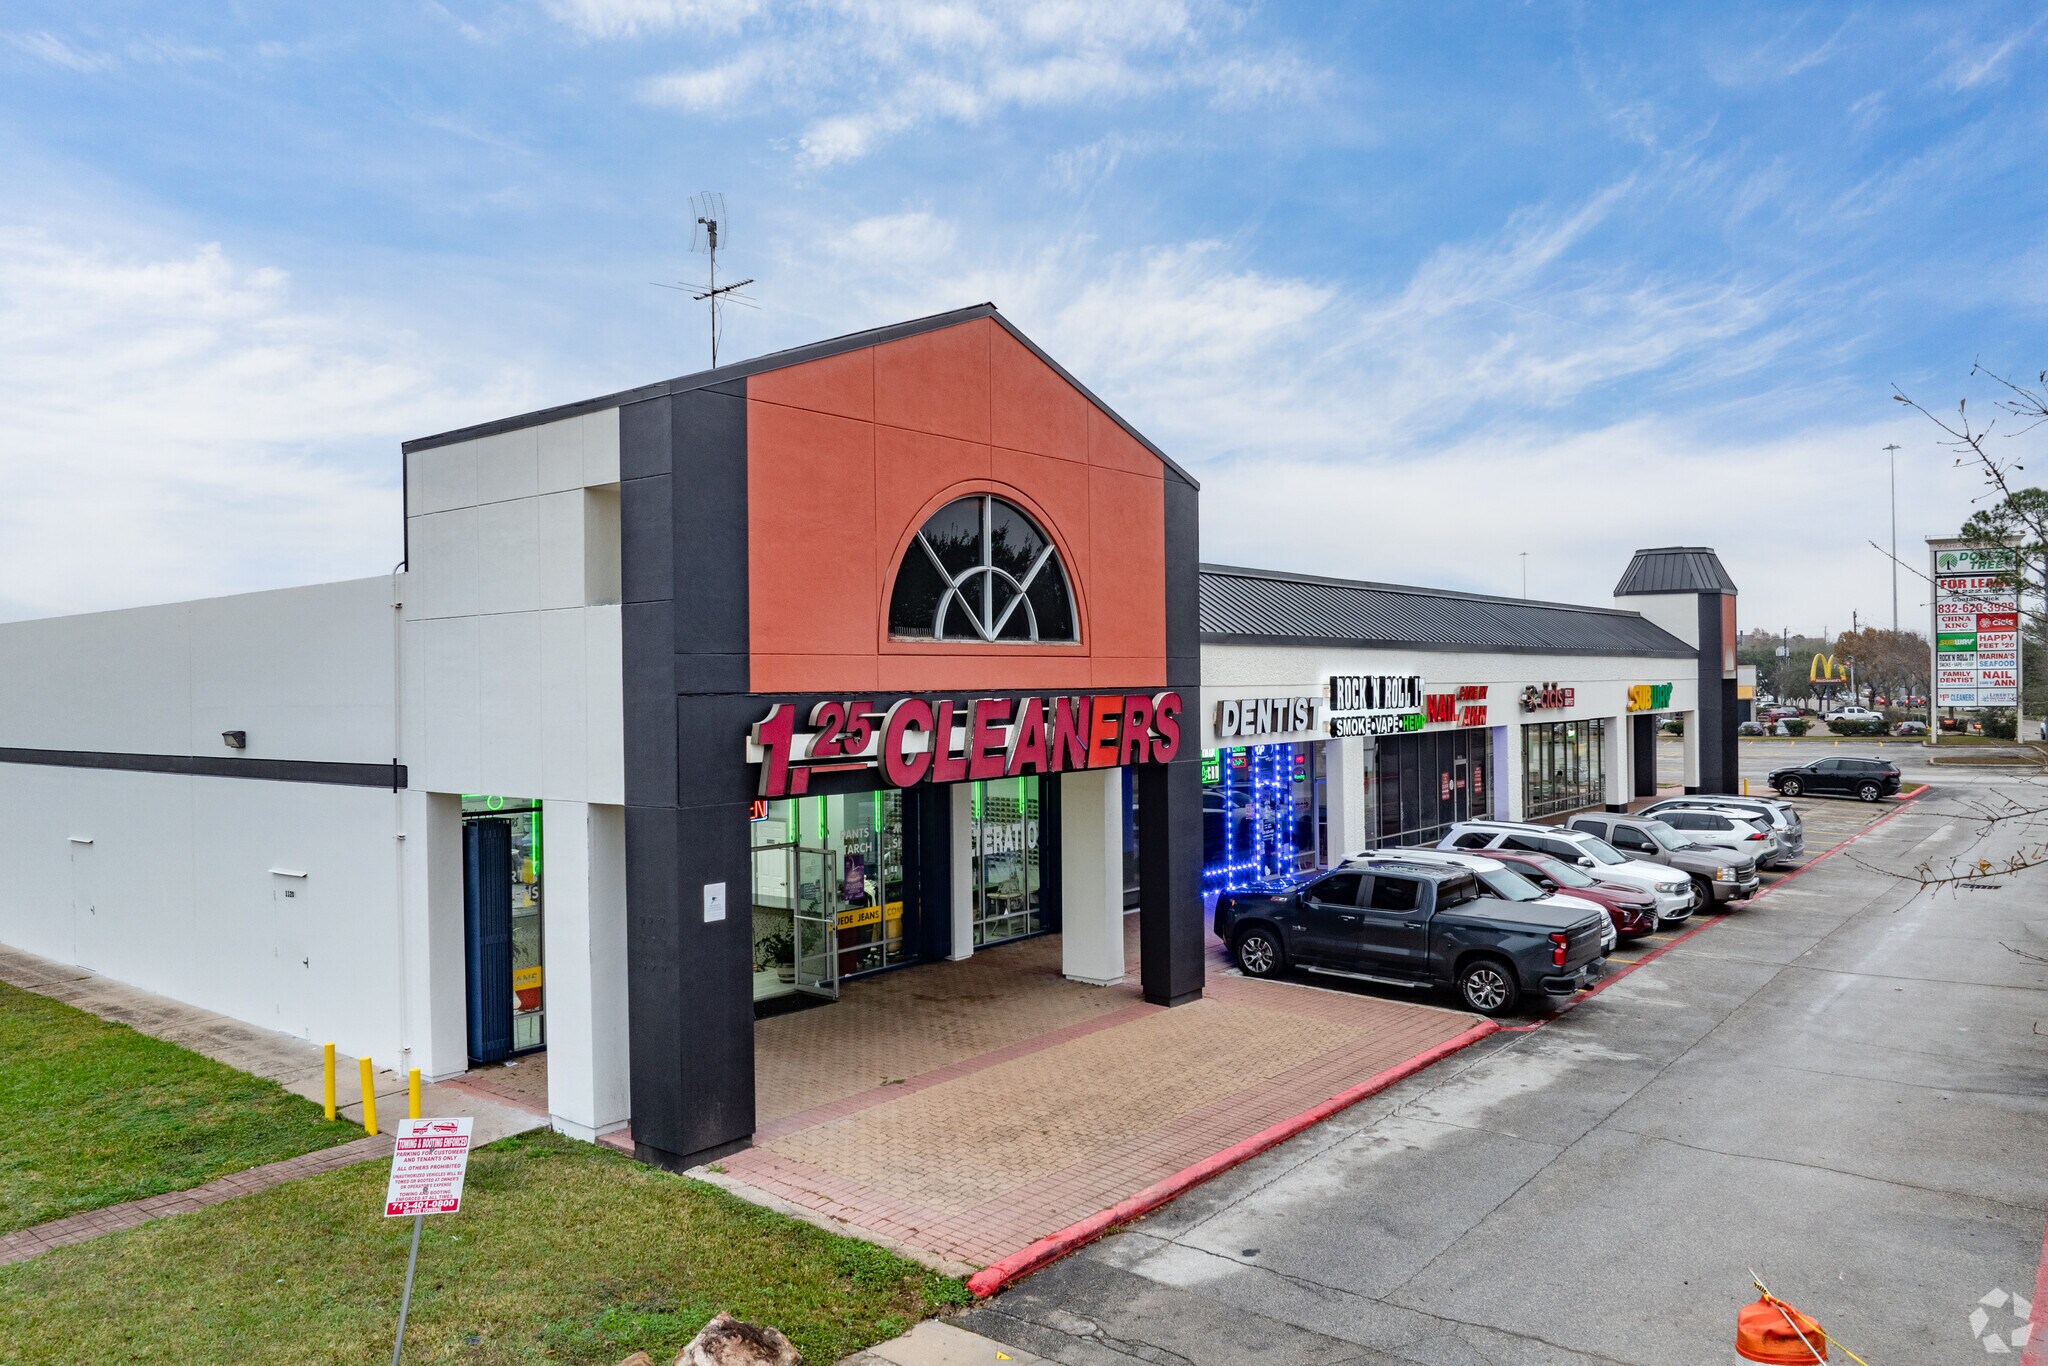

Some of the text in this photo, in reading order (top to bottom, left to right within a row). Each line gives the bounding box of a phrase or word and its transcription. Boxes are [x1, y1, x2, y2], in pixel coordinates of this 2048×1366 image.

[1940, 579, 1967, 589] FOR
[1938, 602, 2014, 613] 832-620-3928
[1336, 677, 1367, 710] ROCK
[1384, 677, 1410, 708] ROLL
[1414, 677, 1425, 707] IT
[1459, 686, 1488, 699] CARE BY
[1629, 682, 1673, 711] SUBWAY
[1426, 694, 1458, 722] NAIL
[1219, 698, 1322, 737] DENTIST
[1462, 705, 1487, 726] ANN
[879, 692, 1182, 788] CLEANERS
[844, 842, 872, 854] TARCH
[857, 910, 880, 921] JEANS
[398, 1138, 418, 1149] TOWING
[422, 1137, 443, 1148] BOOTING
[443, 1136, 468, 1147] ENFORCED
[392, 1200, 454, 1210] 713-401-0800
